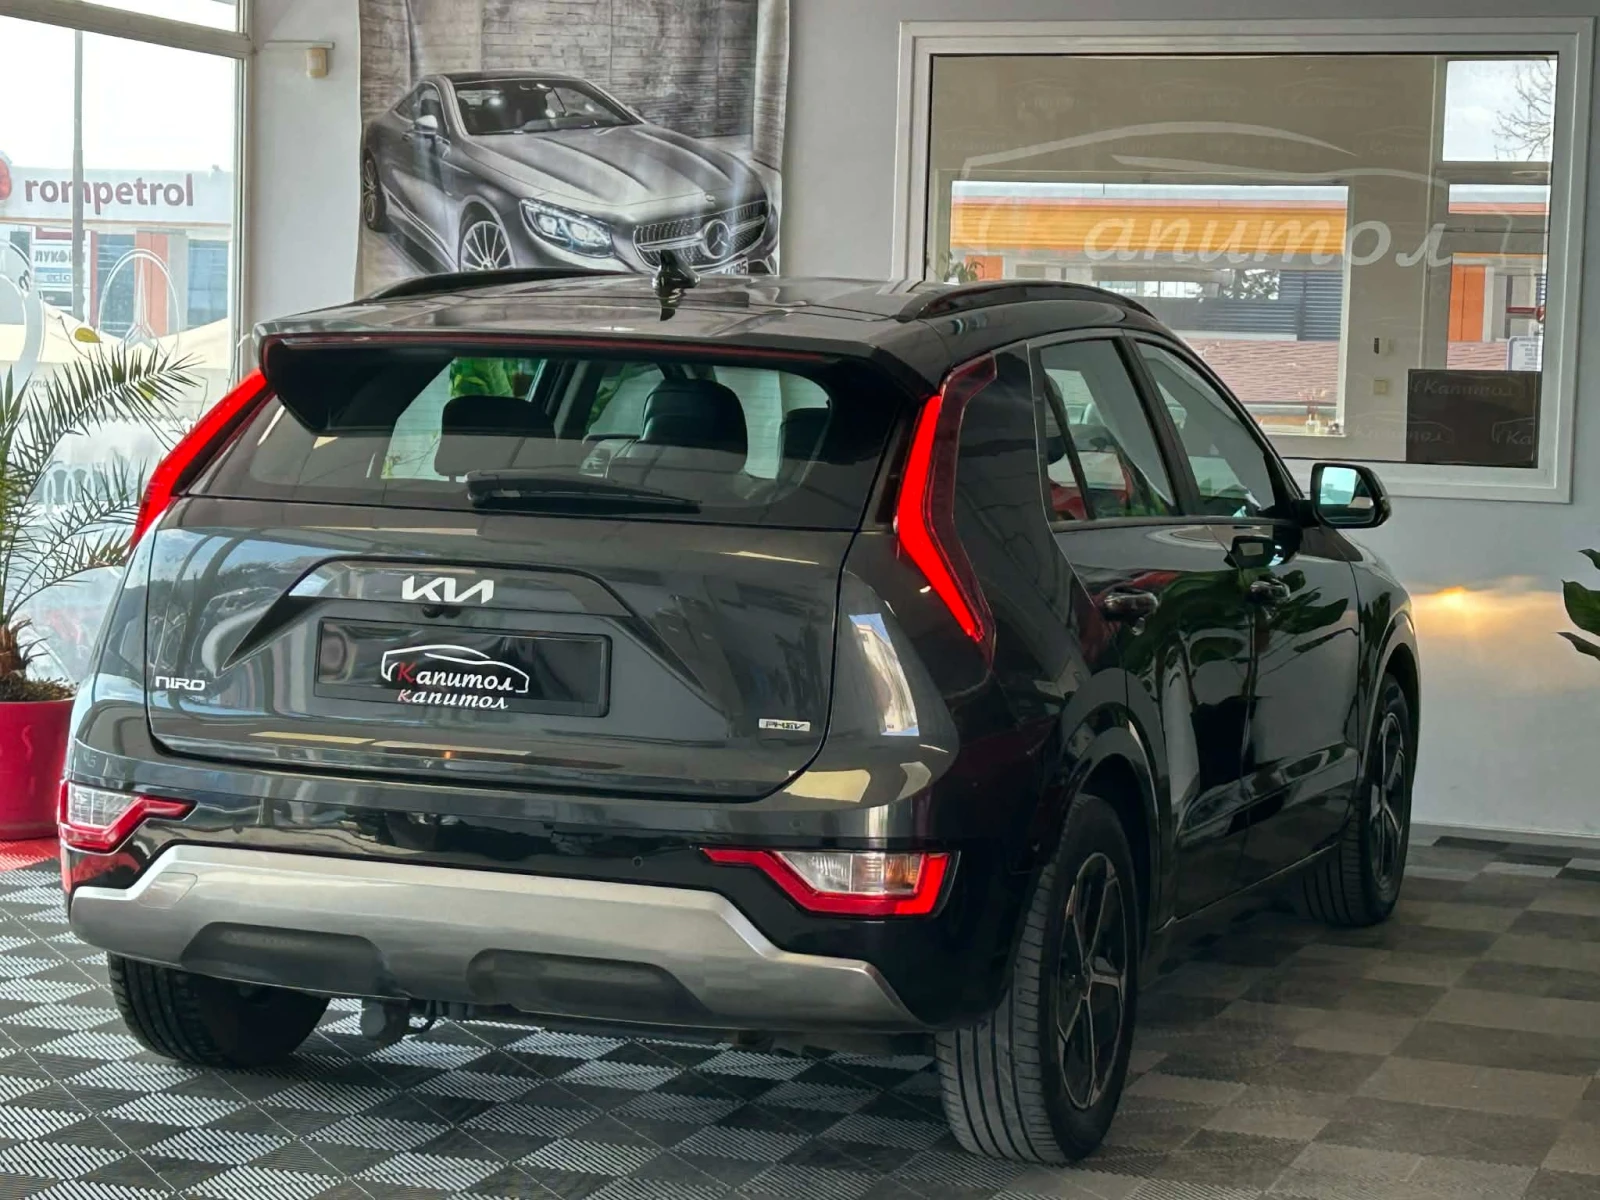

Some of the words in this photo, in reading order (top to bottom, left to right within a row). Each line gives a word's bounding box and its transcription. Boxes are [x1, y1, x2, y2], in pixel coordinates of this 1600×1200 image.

[25, 173, 194, 215] rompetrol
[402, 574, 494, 604] KIA
[155, 675, 206, 691] NIRO
[397, 661, 513, 692] Капитол
